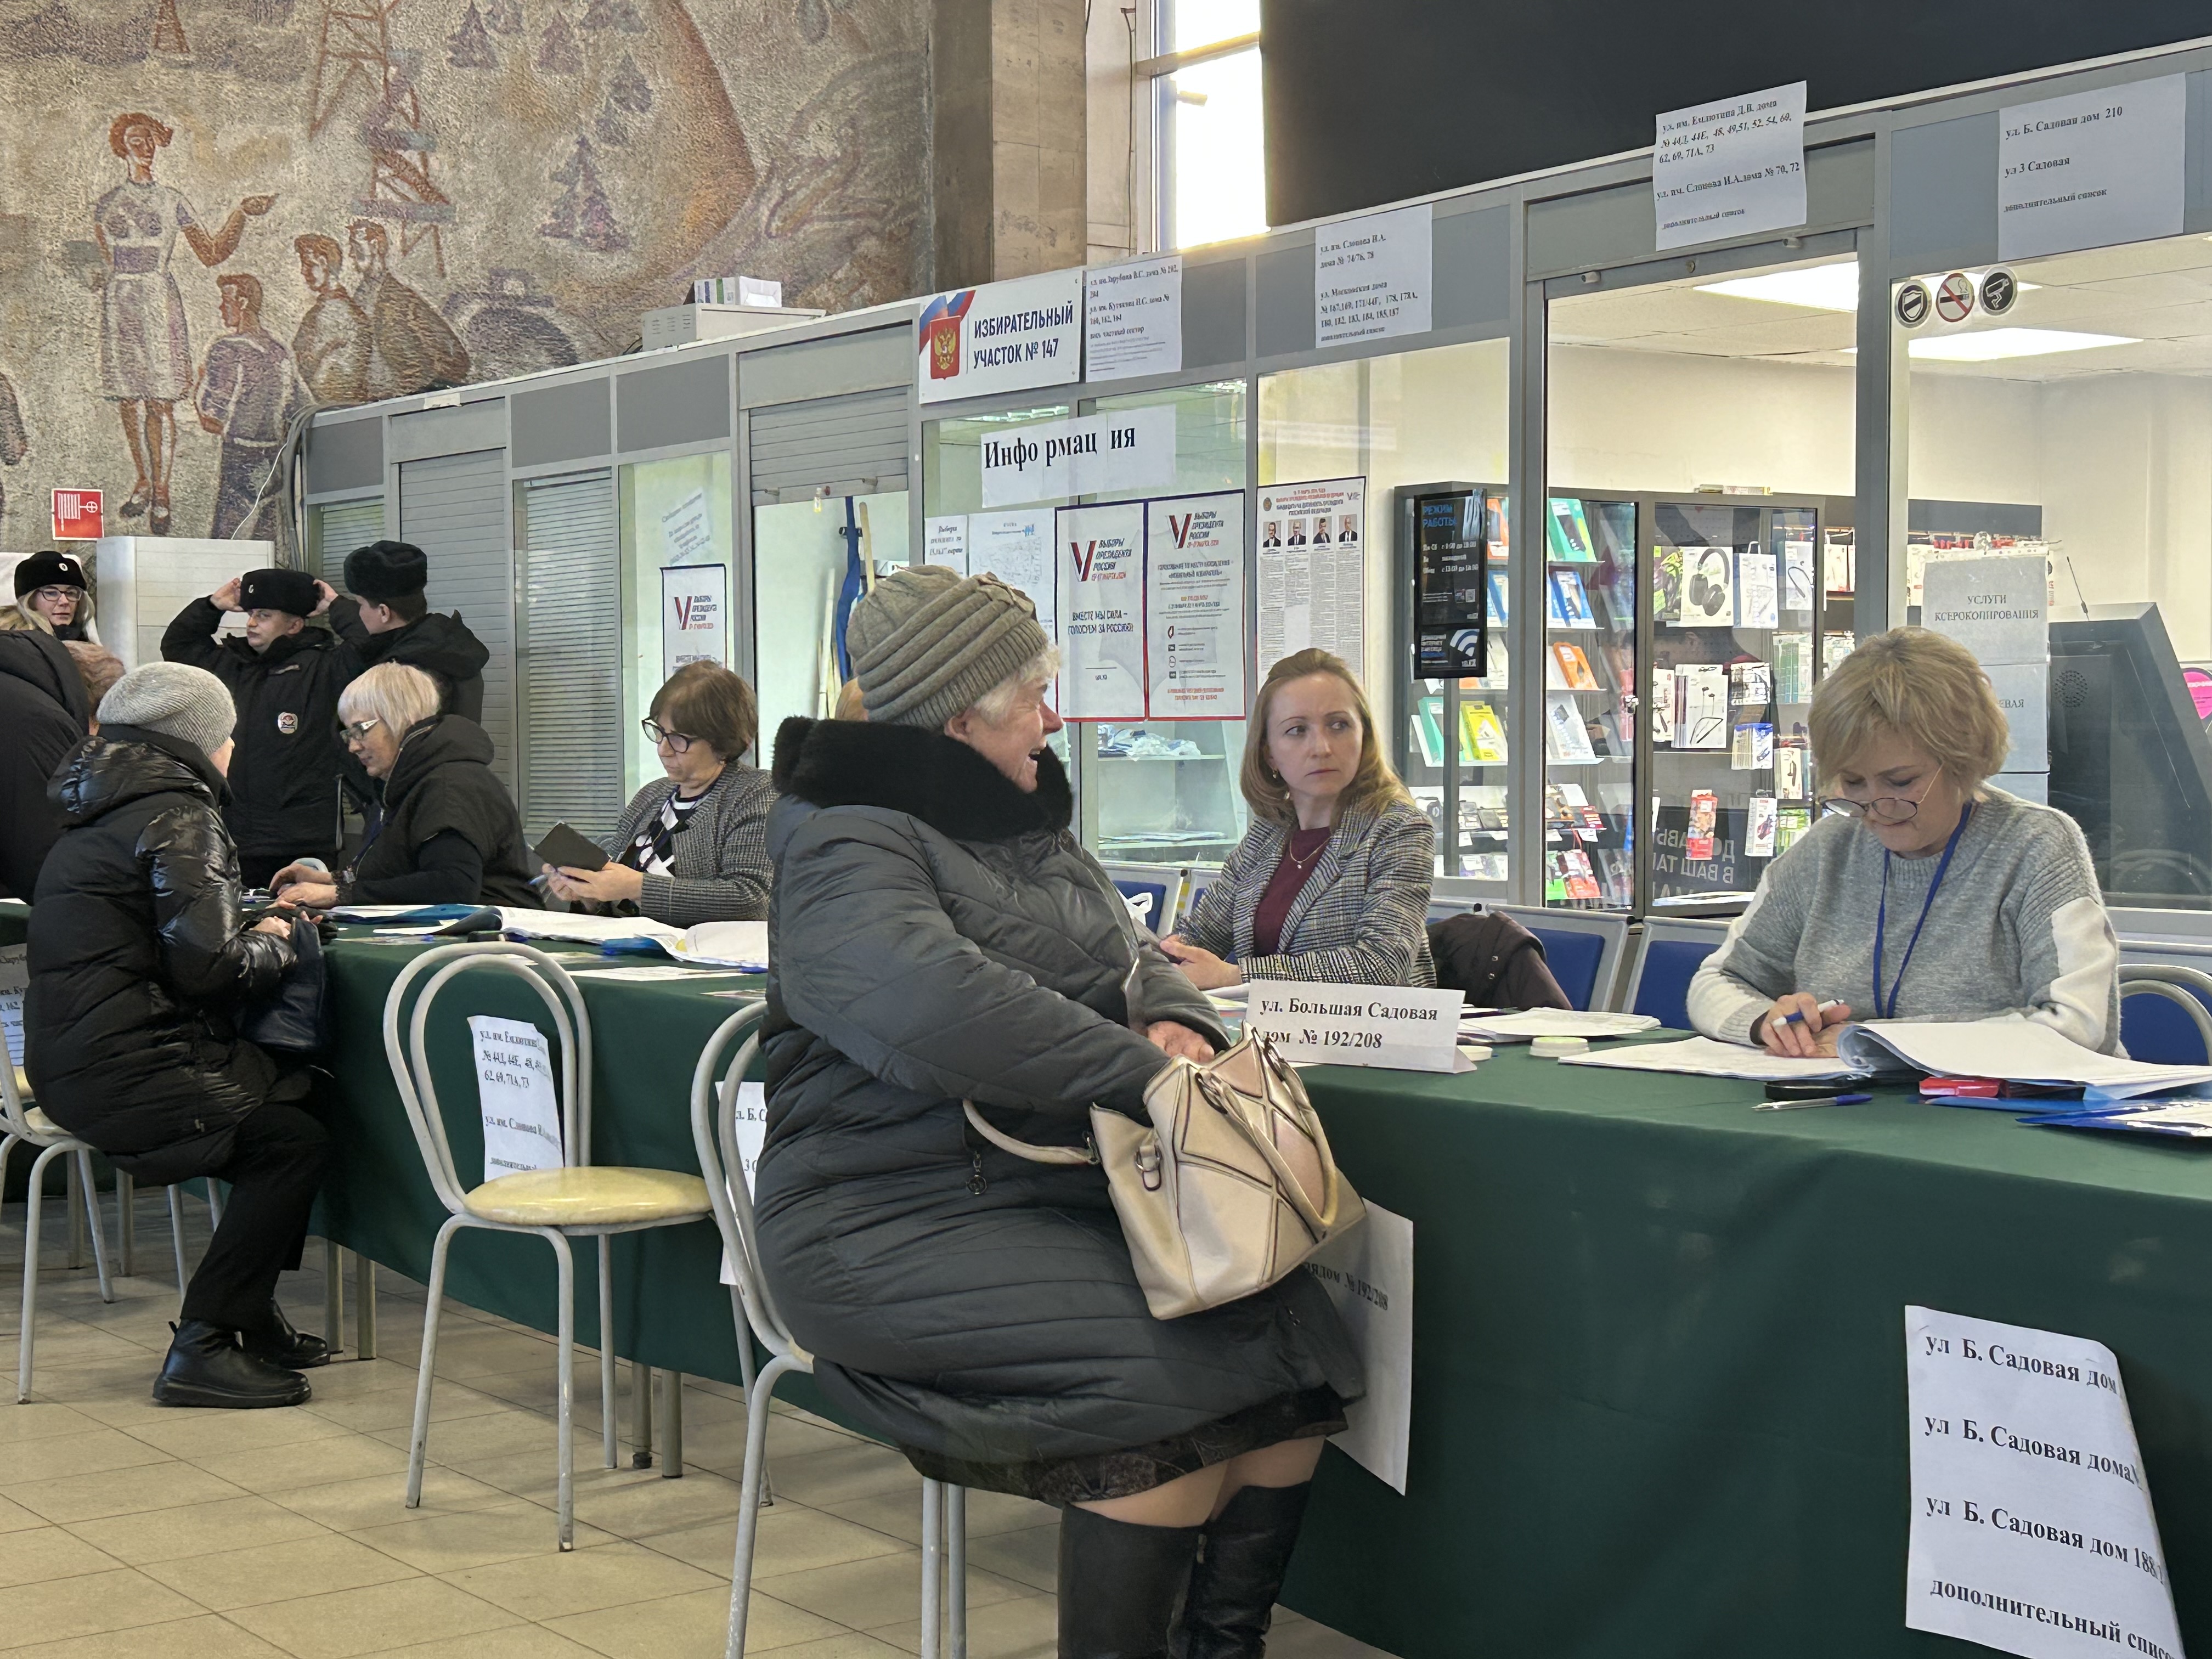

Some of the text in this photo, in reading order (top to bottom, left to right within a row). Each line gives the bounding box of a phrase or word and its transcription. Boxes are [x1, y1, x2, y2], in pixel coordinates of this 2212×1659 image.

[2036, 117, 2078, 132] Садовая
[2080, 112, 2100, 124] дом
[2105, 106, 2123, 119] 210
[2028, 157, 2070, 172] Садовая
[974, 300, 1073, 338] ИЗБИРАТЕЛЬНЫЙ
[973, 338, 1059, 369] УЧАСТОК № 147
[1967, 595, 2006, 605] УСЛУГИ
[1934, 610, 2039, 622] КСЕРОКОПИРОВАНИЯ
[1260, 998, 1438, 1021] ул. Большая Садовая
[1262, 1029, 1383, 1049] дом № 192/208
[1925, 1335, 2118, 1395] ул Б. Садовая дом
[1925, 1415, 1950, 1436] ул
[1962, 1419, 1984, 1443] Б.
[1990, 1425, 2081, 1466] Садовая
[2087, 1453, 2135, 1485] дома
[1926, 1496, 1951, 1517] ул
[1963, 1500, 1985, 1525] Б.
[1991, 1507, 2084, 1550] Садовая
[2090, 1537, 2129, 1563] дом
[1929, 1579, 2179, 1659] дополнительный спис
